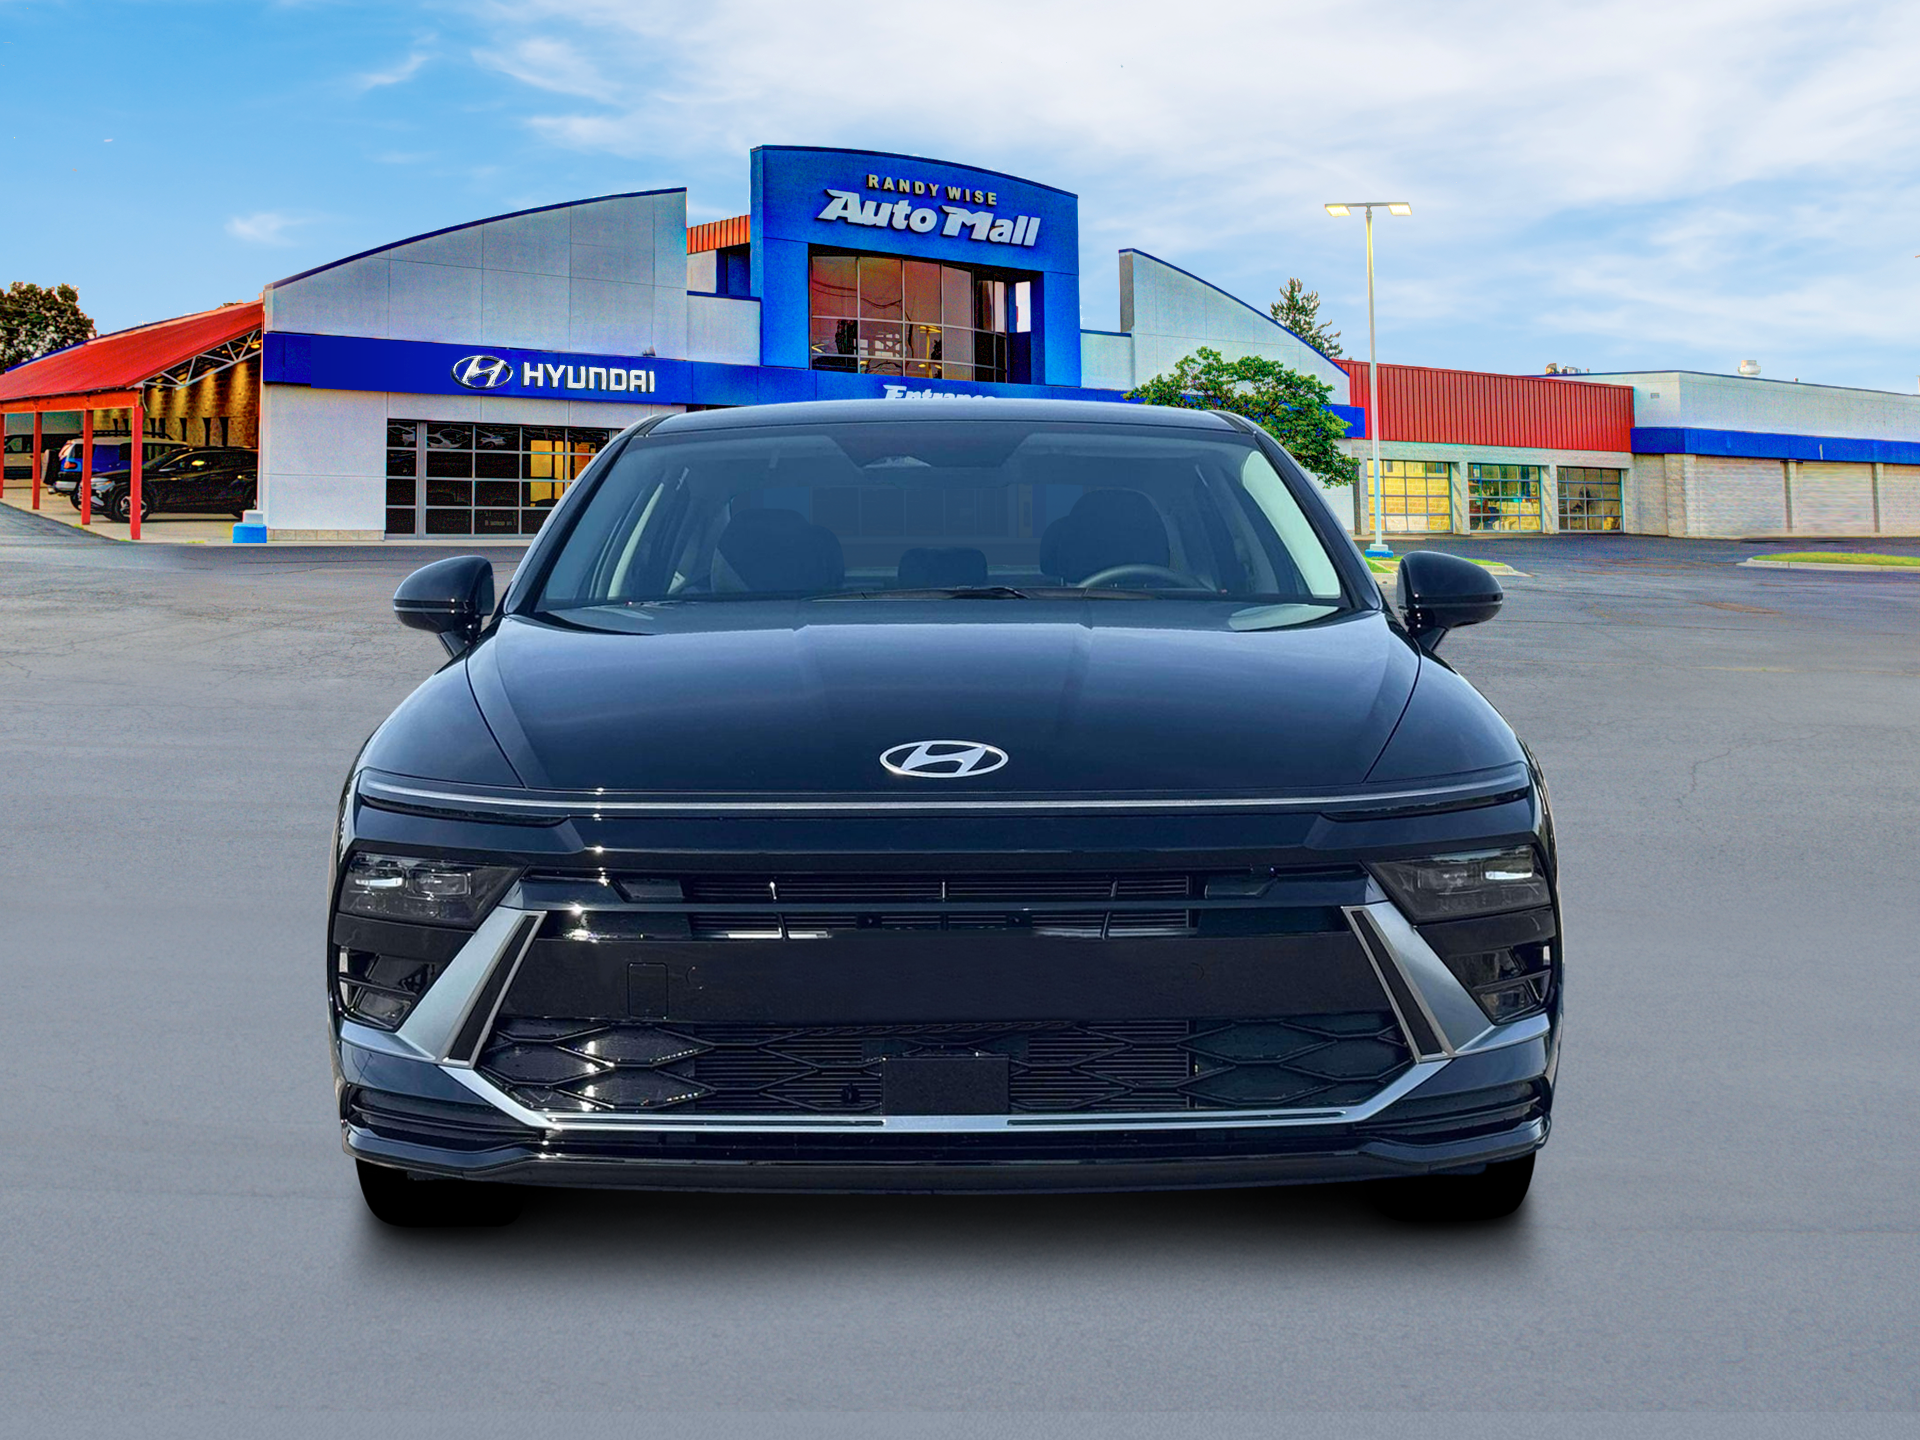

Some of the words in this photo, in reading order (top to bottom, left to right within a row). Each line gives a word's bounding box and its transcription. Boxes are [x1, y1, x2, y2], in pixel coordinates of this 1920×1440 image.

[867, 173, 940, 197] RANDY
[946, 185, 998, 206] WISE
[816, 188, 938, 233] Auto
[940, 204, 1041, 247] Mall
[521, 361, 656, 393] HYUNDAI
